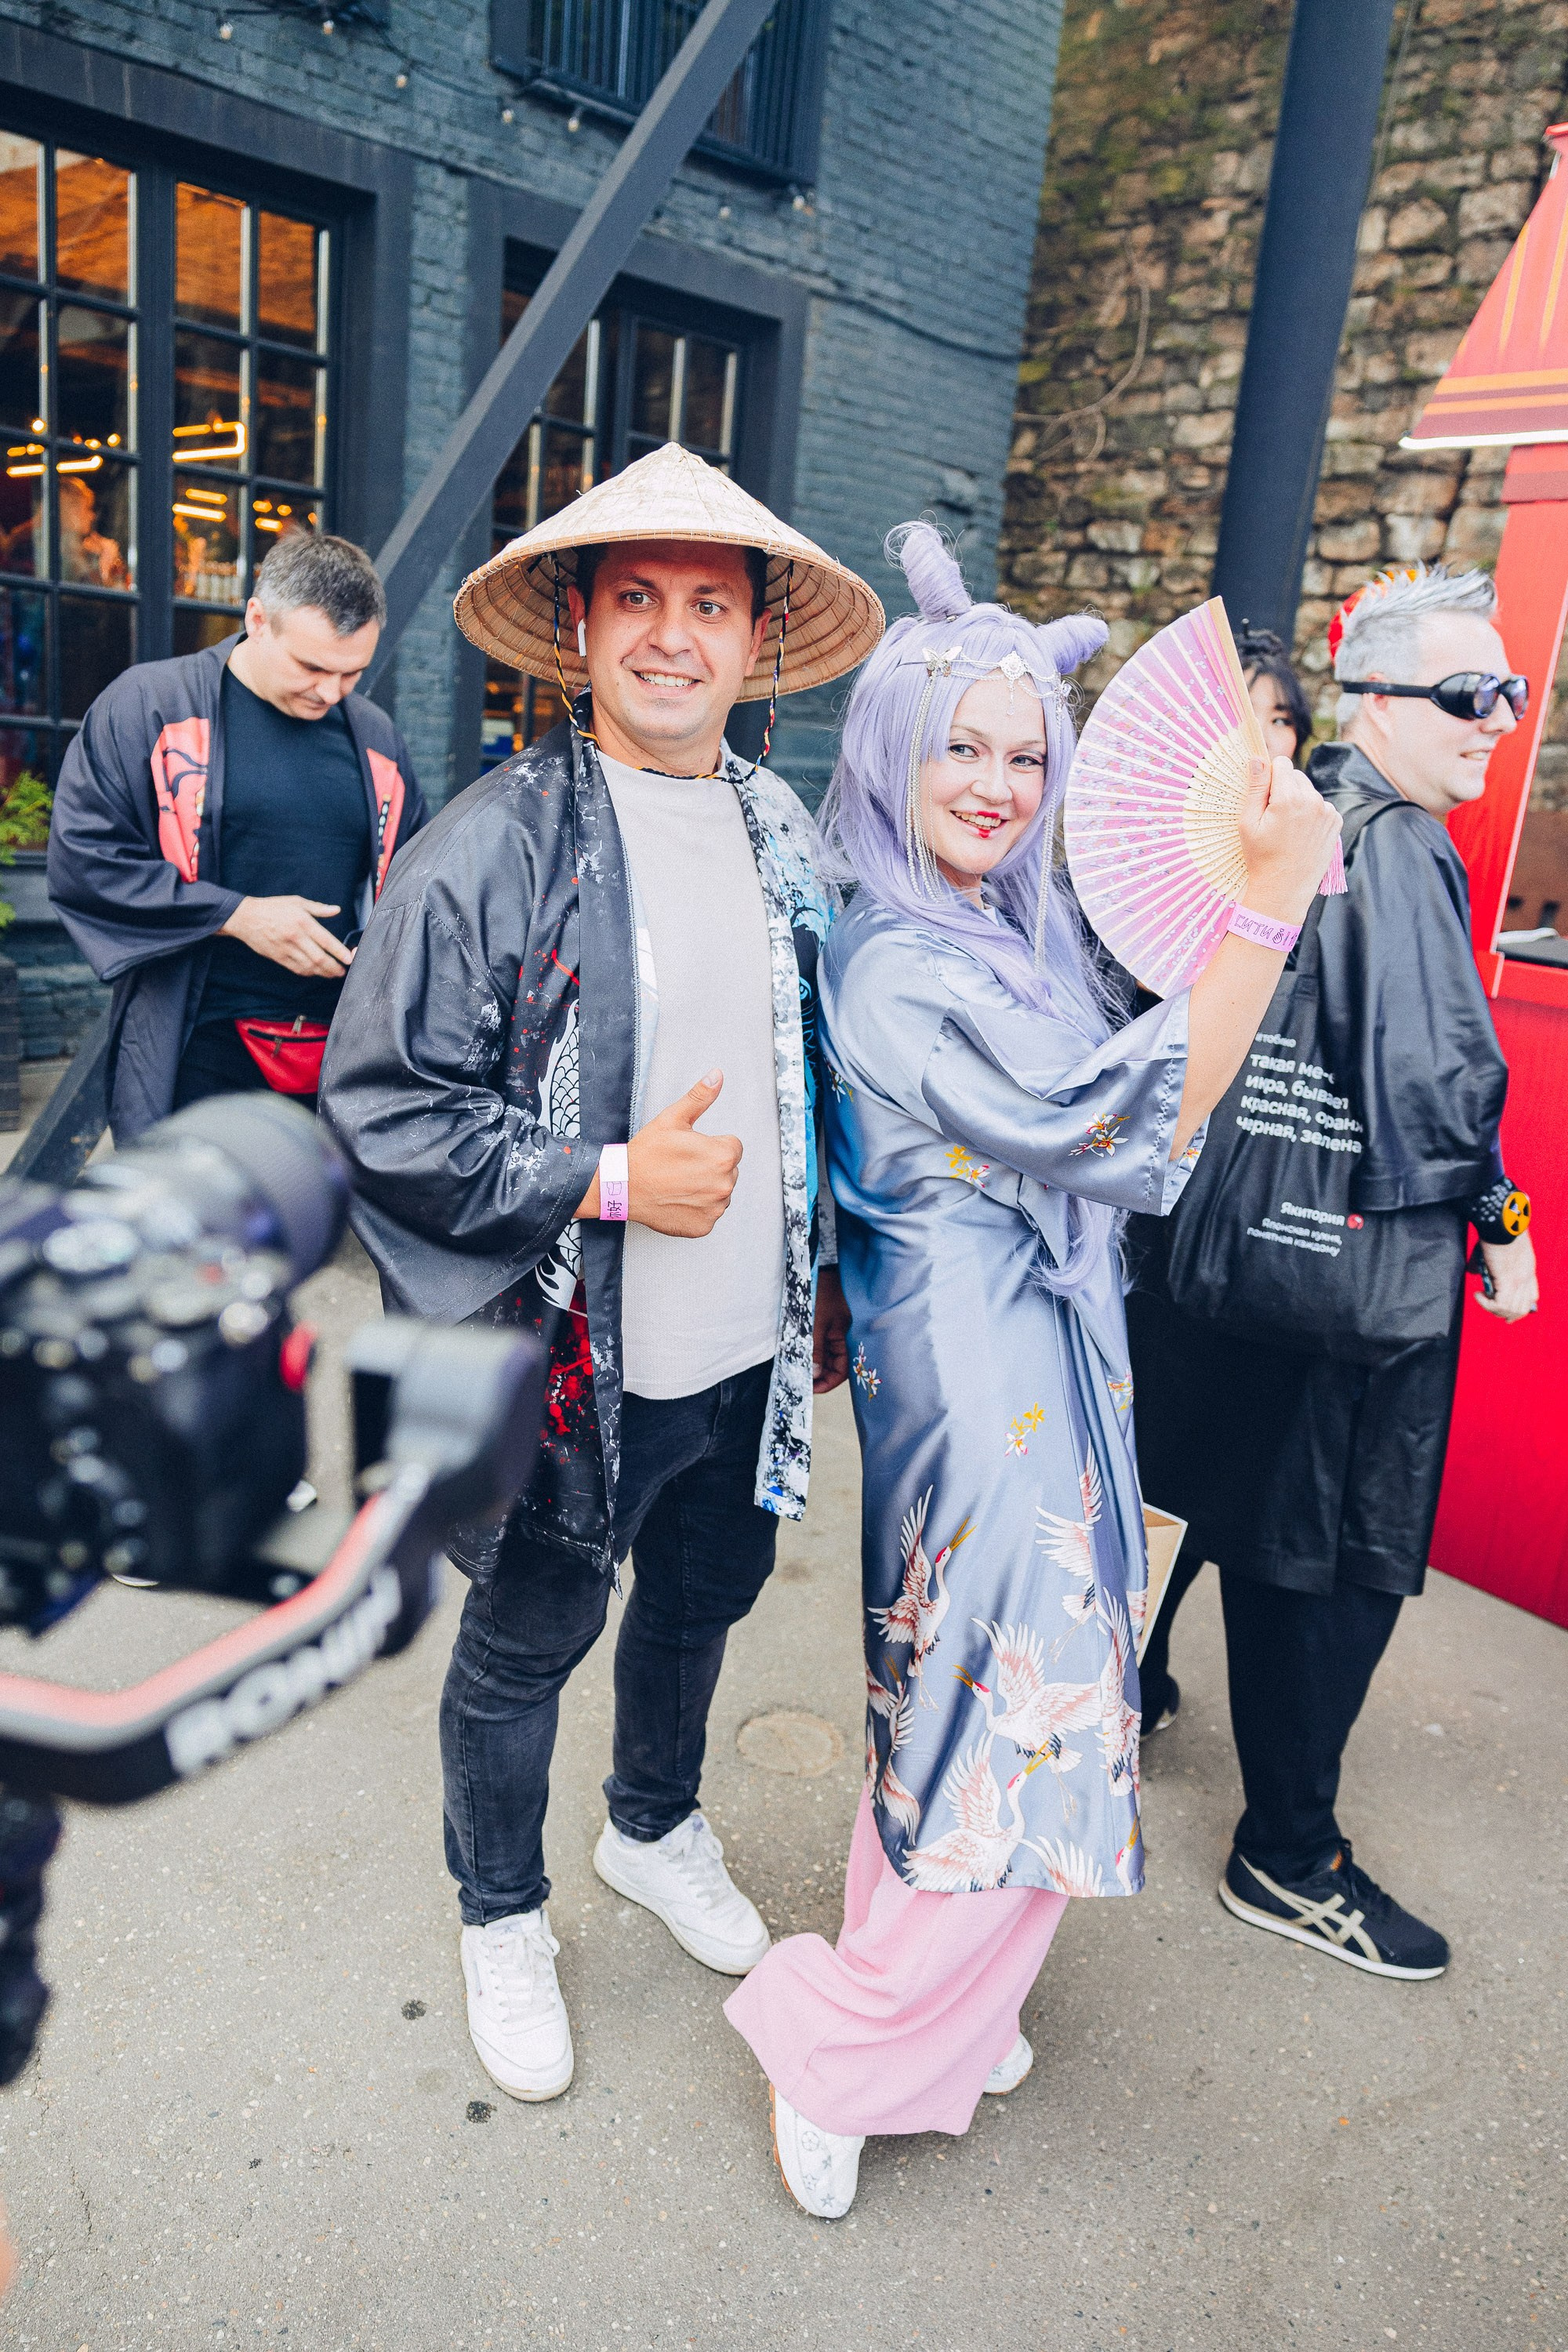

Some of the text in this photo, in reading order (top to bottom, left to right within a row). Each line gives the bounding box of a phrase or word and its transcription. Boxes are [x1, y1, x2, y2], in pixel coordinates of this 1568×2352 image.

[1250, 1054, 1296, 1073] такая
[1240, 1095, 1312, 1123] красная,
[607, 1200, 622, 1219] 你好
[1280, 1201, 1345, 1226] Якитория
